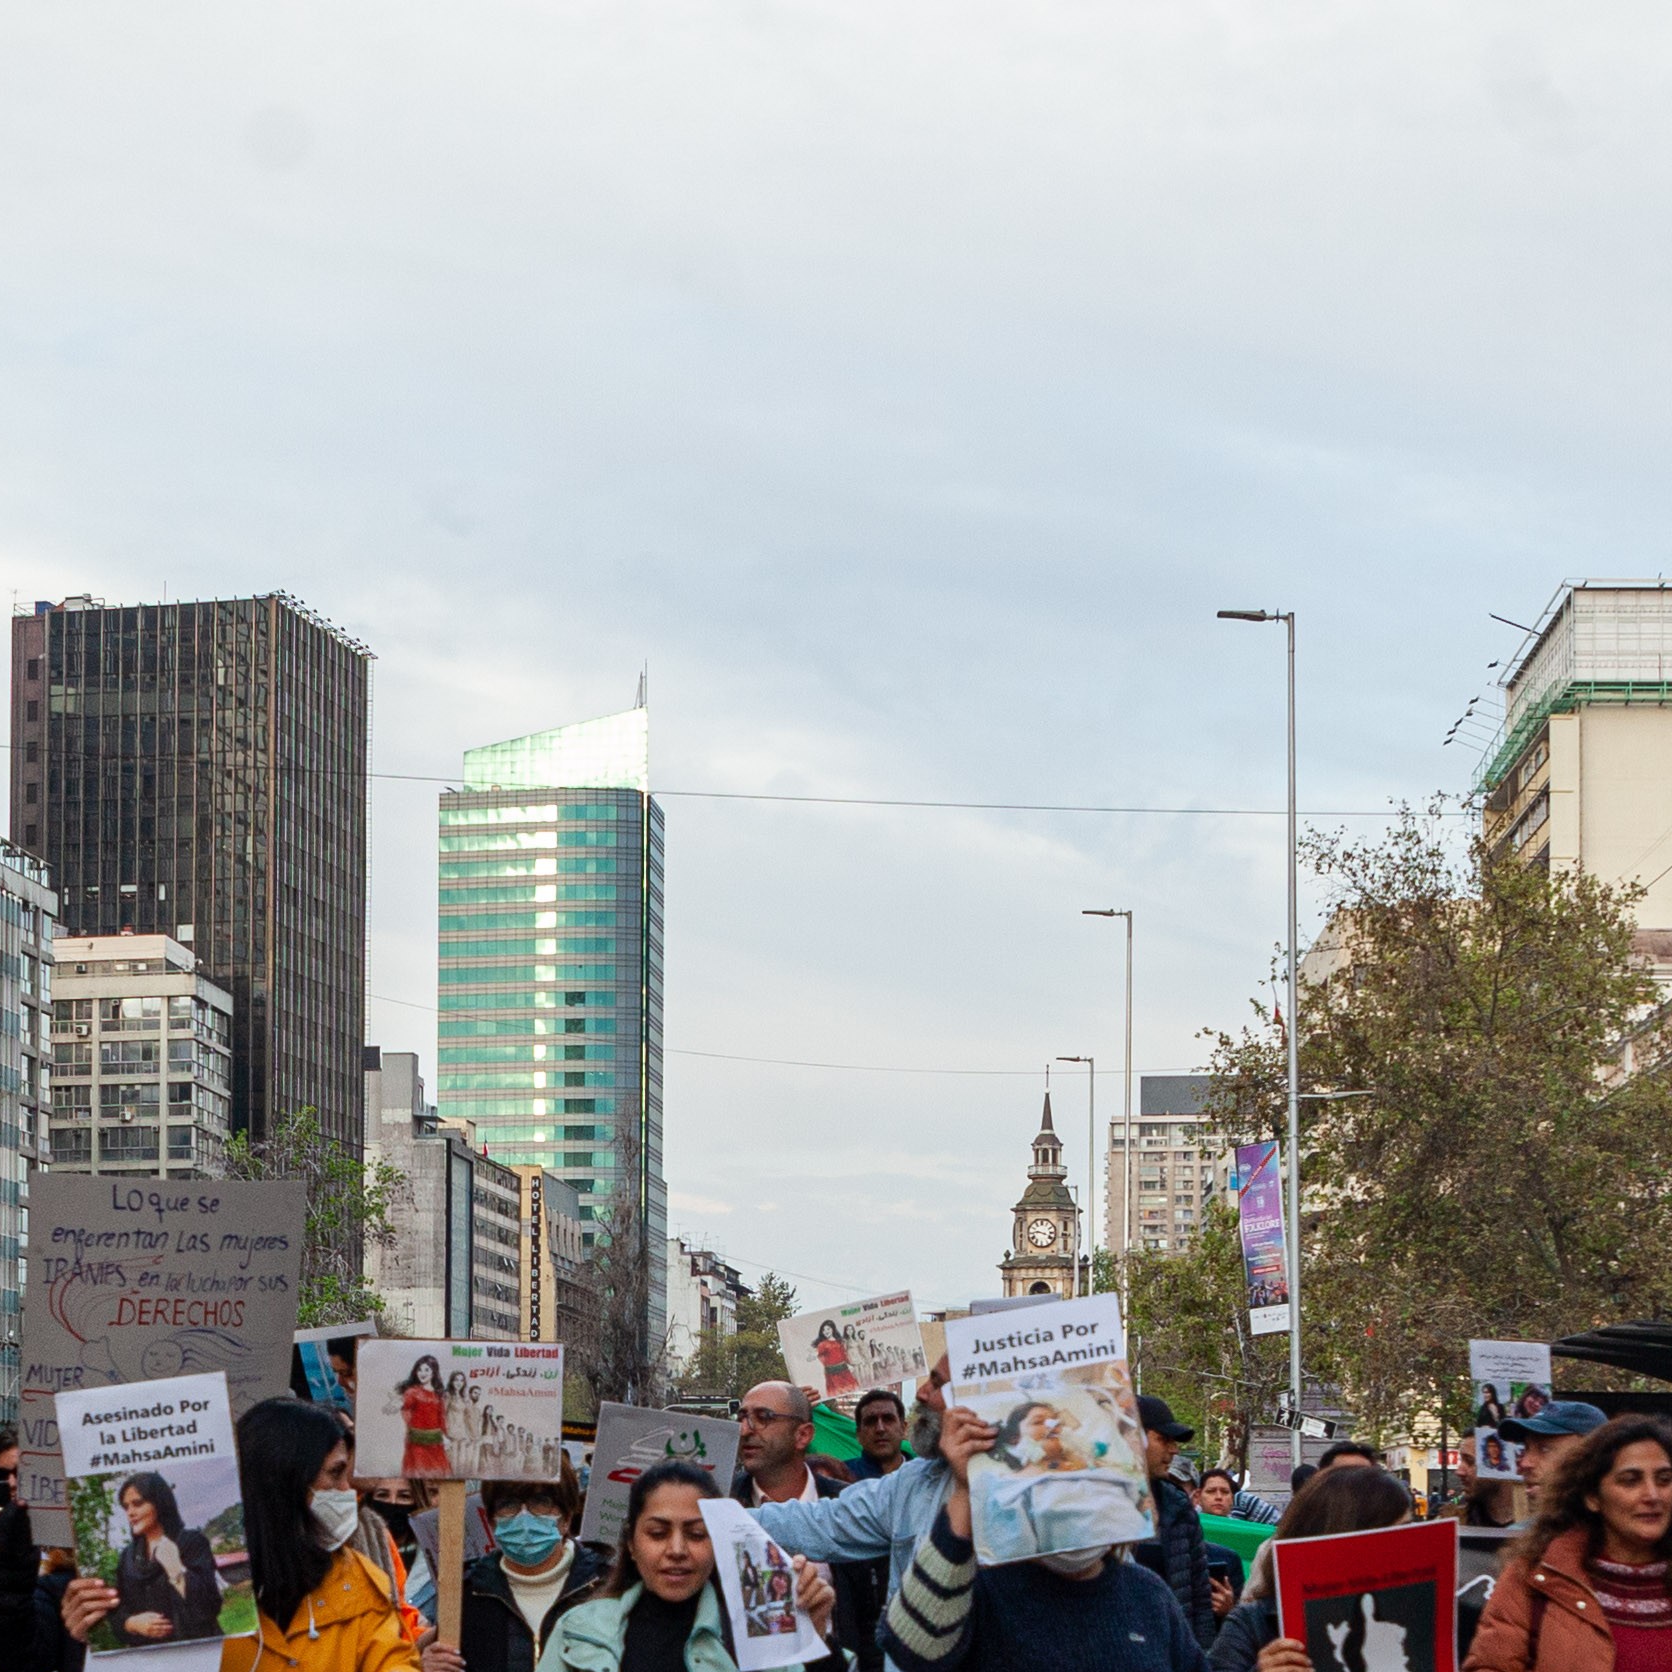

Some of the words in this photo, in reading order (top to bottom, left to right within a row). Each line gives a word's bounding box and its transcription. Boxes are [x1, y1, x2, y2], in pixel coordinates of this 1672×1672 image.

[148, 1193, 189, 1223] que
[199, 1196, 220, 1213] se
[531, 1179, 540, 1236] HOTEL
[220, 1233, 289, 1269] mujeres
[138, 1271, 160, 1287] en
[186, 1270, 226, 1293] lucha
[258, 1274, 289, 1292] sus
[530, 1244, 539, 1338] LIBERTAD
[108, 1297, 245, 1328] DERECHOS
[452, 1345, 483, 1358] Mujer
[486, 1346, 510, 1358] Vida
[514, 1346, 559, 1359] Libertad
[973, 1328, 1054, 1354] Justicia
[1062, 1322, 1099, 1339] Por
[962, 1339, 1116, 1380] #MahsaAmini
[26, 1364, 84, 1393] MUJER
[82, 1403, 174, 1426] Asesinado
[180, 1400, 210, 1413] Por
[22, 1419, 60, 1448] VID
[100, 1430, 116, 1445] la
[122, 1420, 198, 1442] Libertad
[91, 1439, 215, 1468] #MahsaAmini
